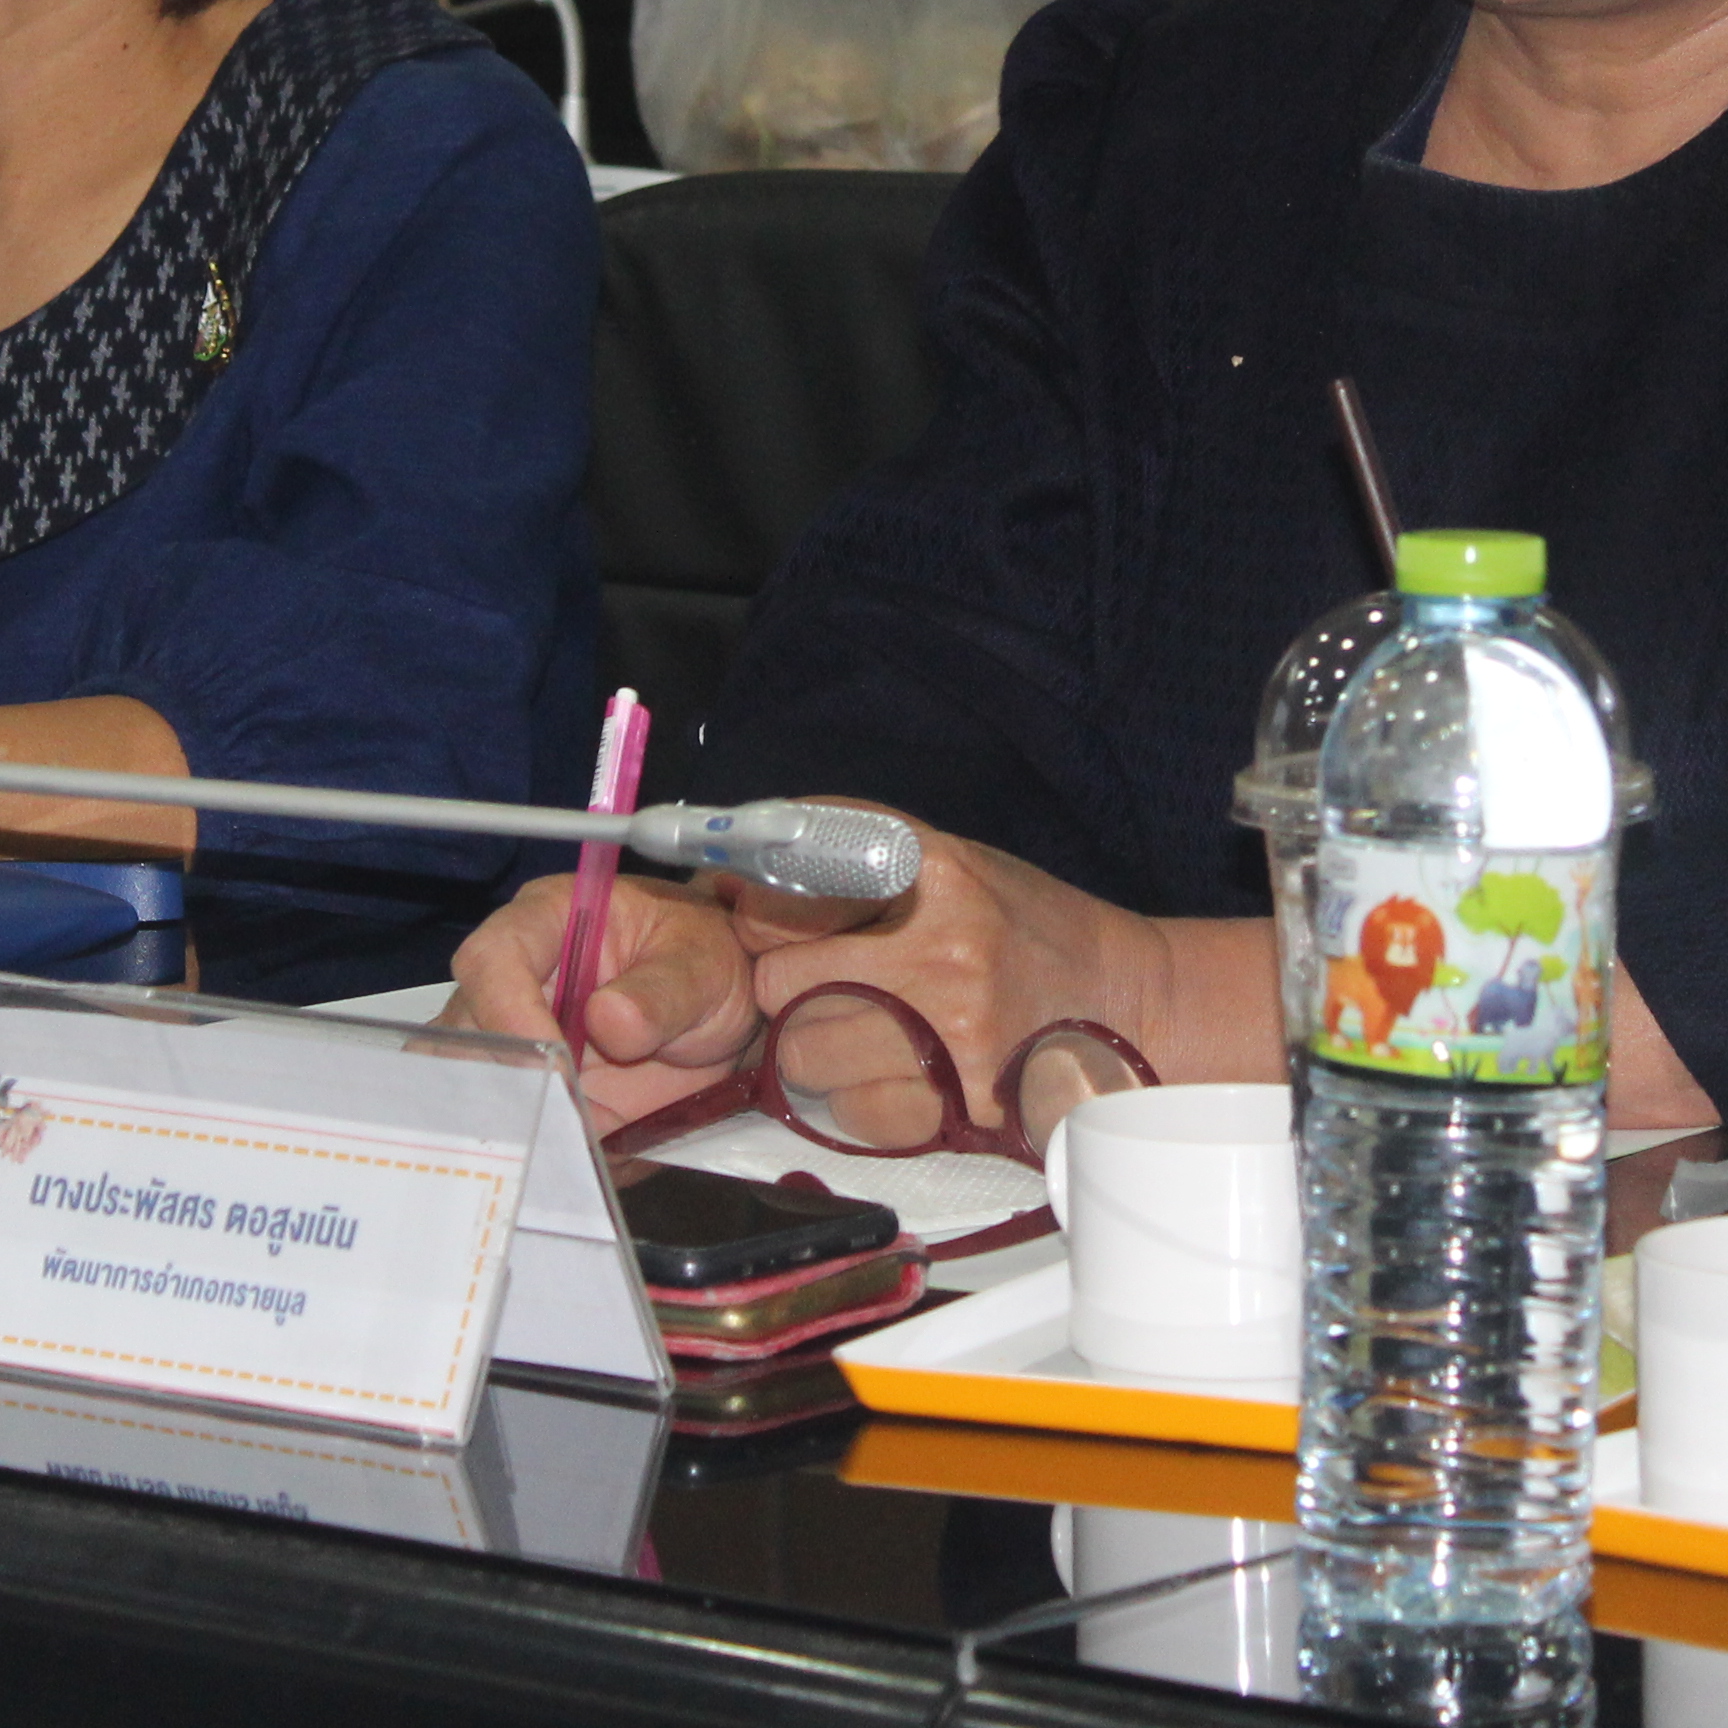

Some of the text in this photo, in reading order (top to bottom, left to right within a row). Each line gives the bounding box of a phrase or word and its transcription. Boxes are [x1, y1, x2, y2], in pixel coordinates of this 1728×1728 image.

[29, 1171, 217, 1231] นางประพัสศร
[41, 1246, 307, 1327] พัฒนาการอำเภอทรายมูล
